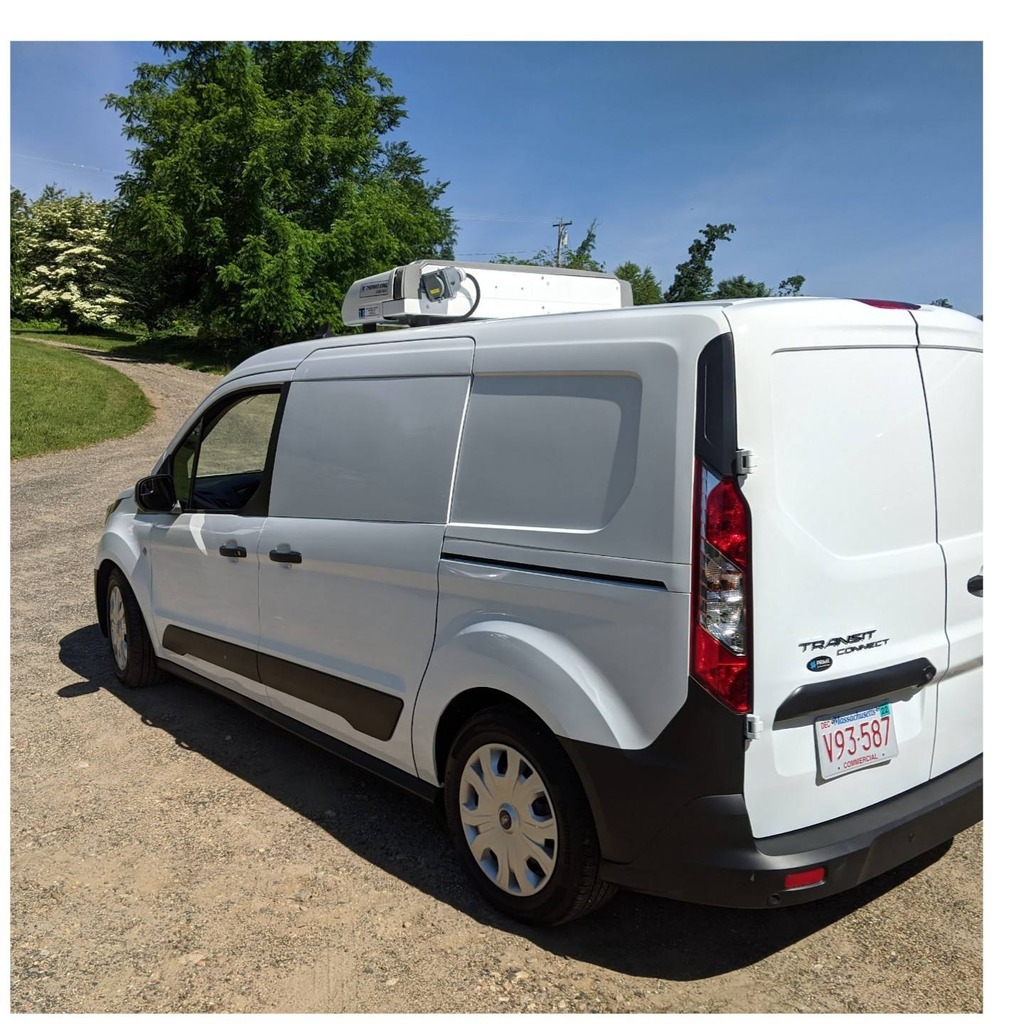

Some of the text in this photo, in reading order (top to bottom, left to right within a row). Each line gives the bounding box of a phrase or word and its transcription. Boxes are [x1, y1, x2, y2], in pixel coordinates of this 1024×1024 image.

[798, 629, 877, 653] TRANSIT
[836, 638, 890, 656] CONNECT
[820, 721, 831, 730] DEC
[880, 705, 890, 715] 22
[843, 753, 879, 769] COMMERCIAL
